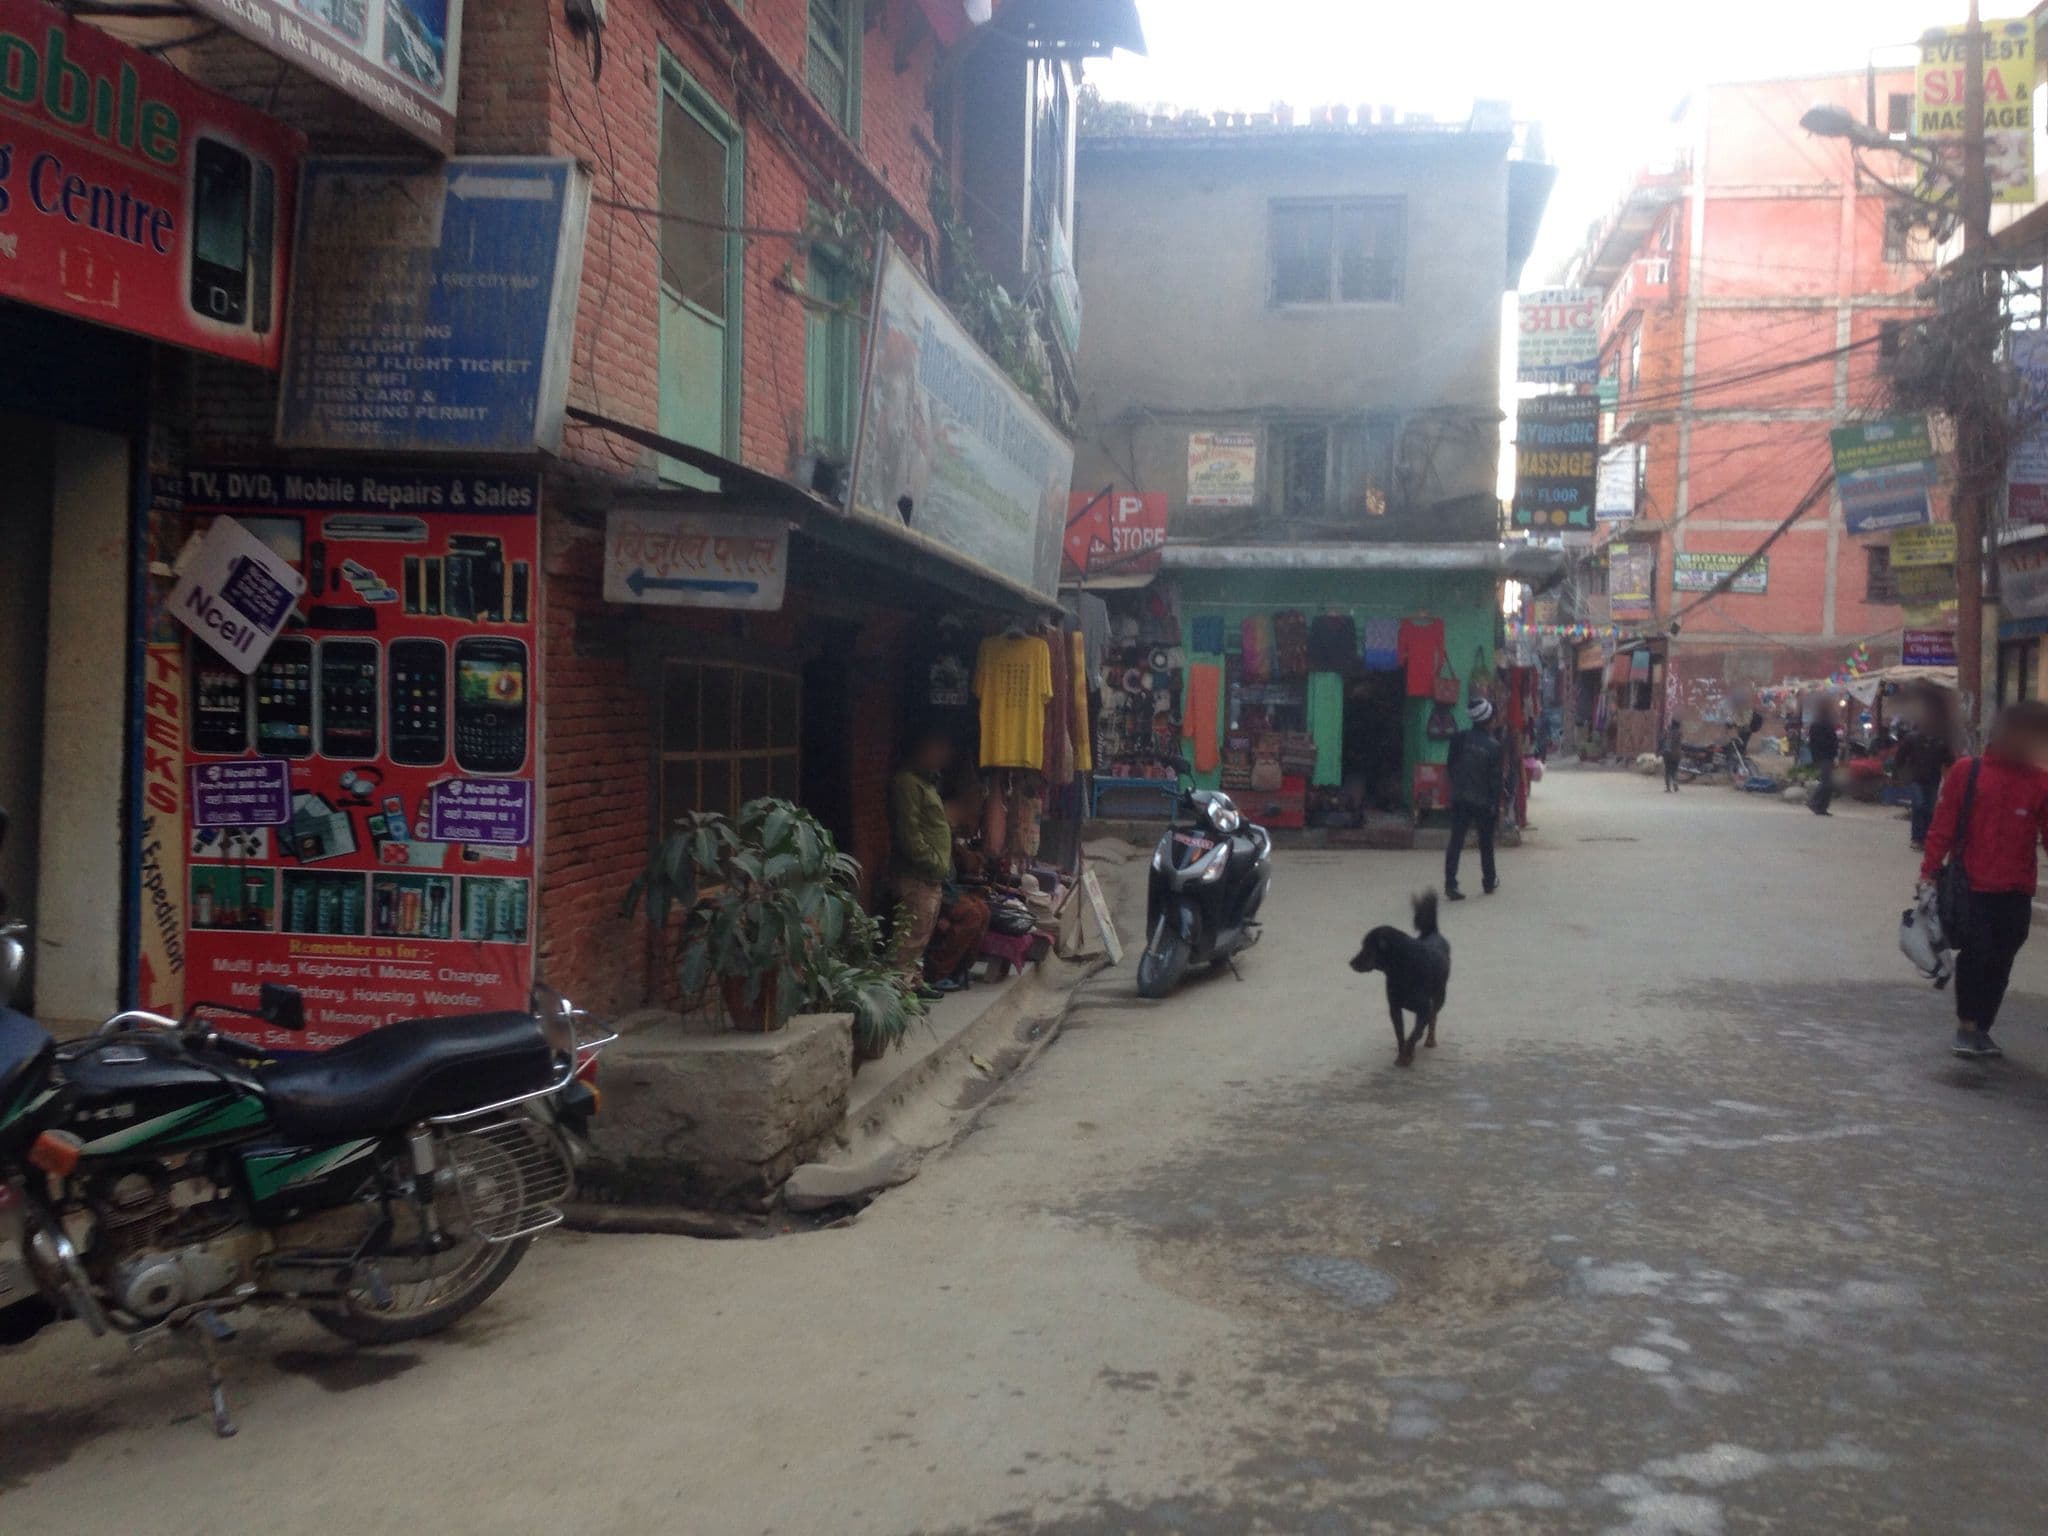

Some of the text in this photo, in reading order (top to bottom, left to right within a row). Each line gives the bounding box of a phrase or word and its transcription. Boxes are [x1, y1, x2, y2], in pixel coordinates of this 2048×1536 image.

[1922, 39, 2028, 64] EVEEST
[29, 152, 174, 256] Centre
[316, 355, 533, 374] CHEAP FLIGHT TICKET
[416, 406, 488, 420] PERMIT
[189, 472, 221, 502] TV,
[227, 475, 278, 504] DVD,
[284, 474, 354, 503] Mobile
[362, 478, 443, 509] Repairs
[449, 481, 466, 505] &
[472, 480, 532, 507] Sales
[1112, 527, 1165, 553] STORE
[186, 585, 256, 654] Ncell
[289, 939, 372, 957] Remember
[376, 946, 392, 957] us
[396, 946, 418, 958] for
[213, 958, 252, 973] Multi
